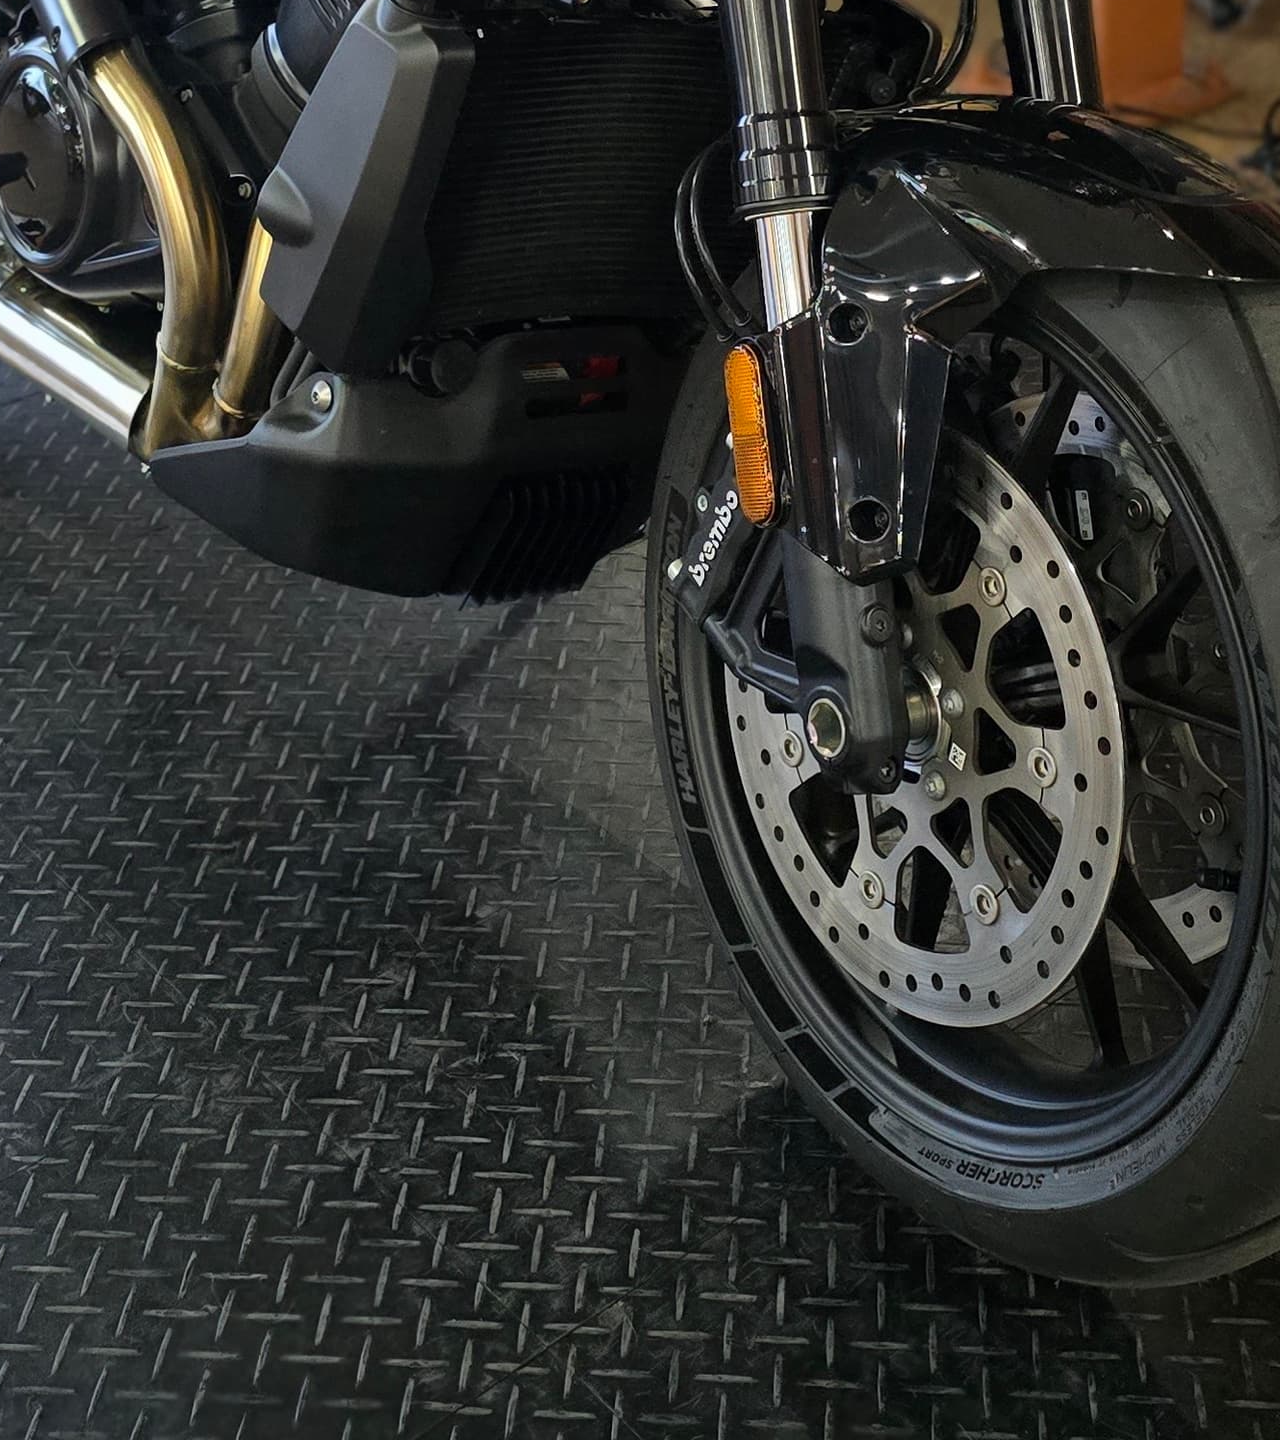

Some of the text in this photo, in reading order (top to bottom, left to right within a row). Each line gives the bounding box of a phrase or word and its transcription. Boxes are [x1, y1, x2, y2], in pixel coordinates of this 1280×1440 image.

[688, 490, 739, 587] brembo
[917, 1146, 1045, 1189] SCORCHER SPORT
